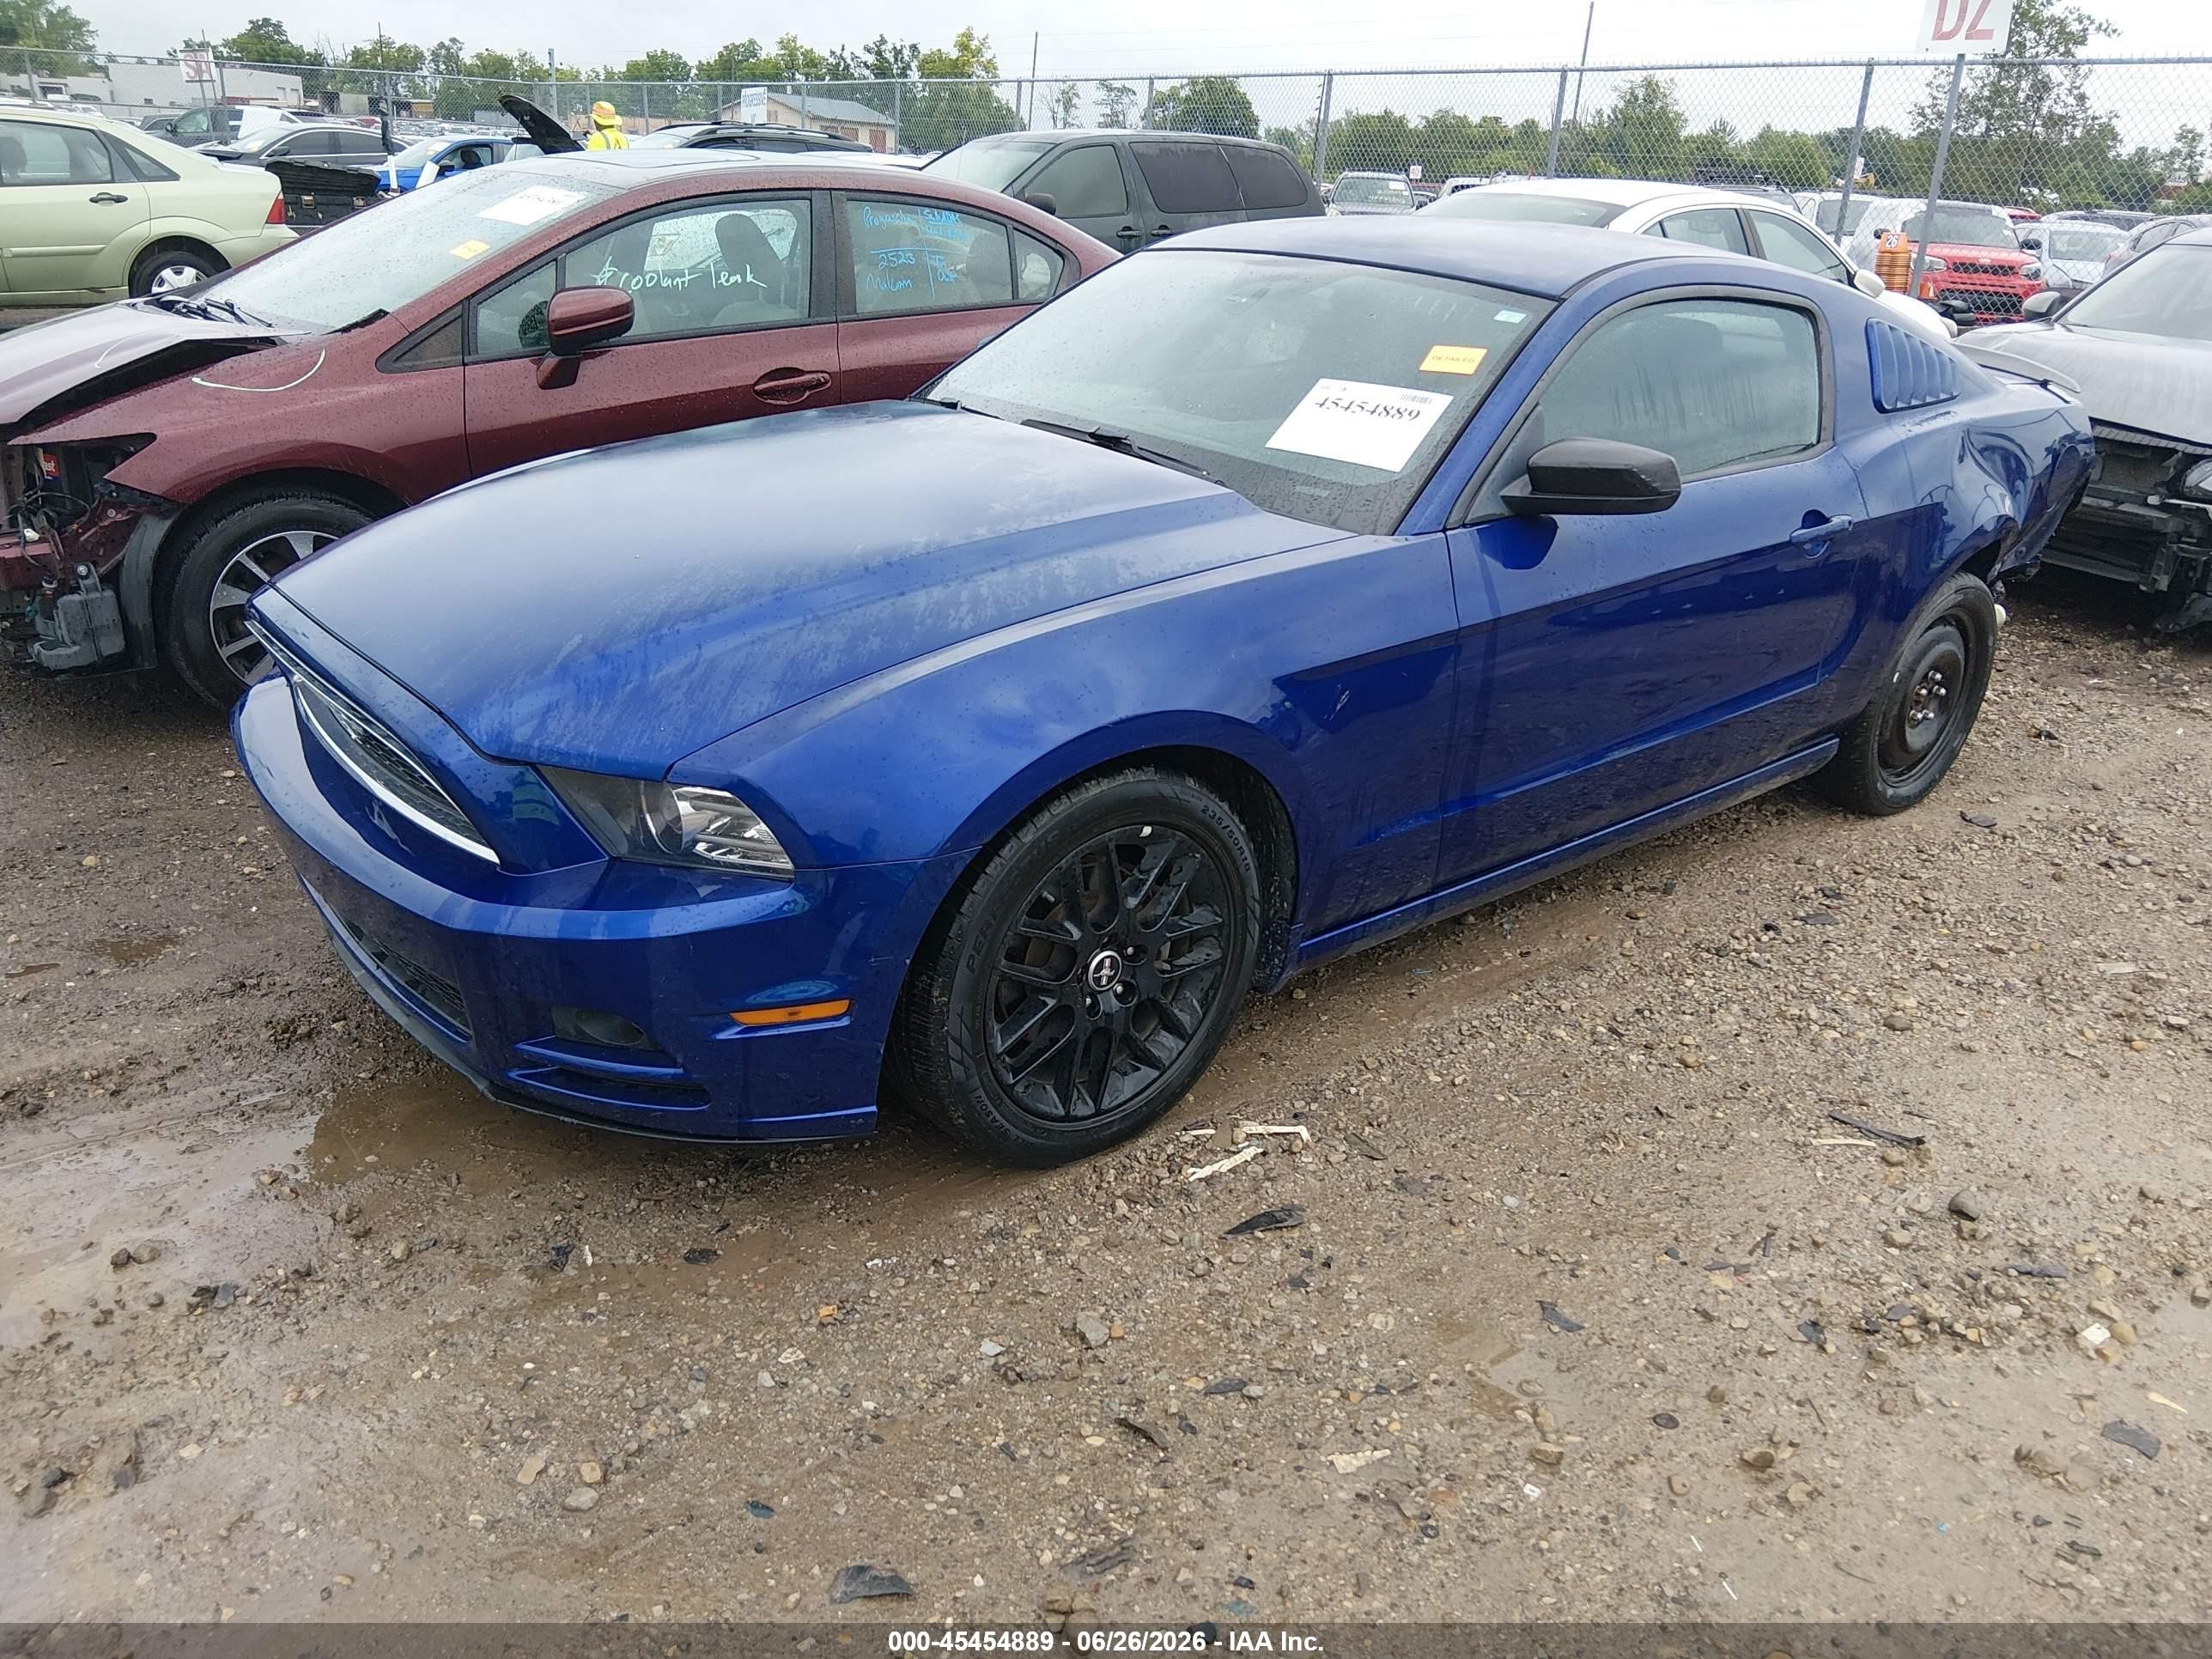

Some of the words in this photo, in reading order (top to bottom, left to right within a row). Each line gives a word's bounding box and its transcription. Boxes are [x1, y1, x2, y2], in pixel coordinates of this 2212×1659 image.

[1885, 234, 1899, 248] 26
[709, 262, 768, 289] leak
[1314, 396, 1421, 422] 45454889
